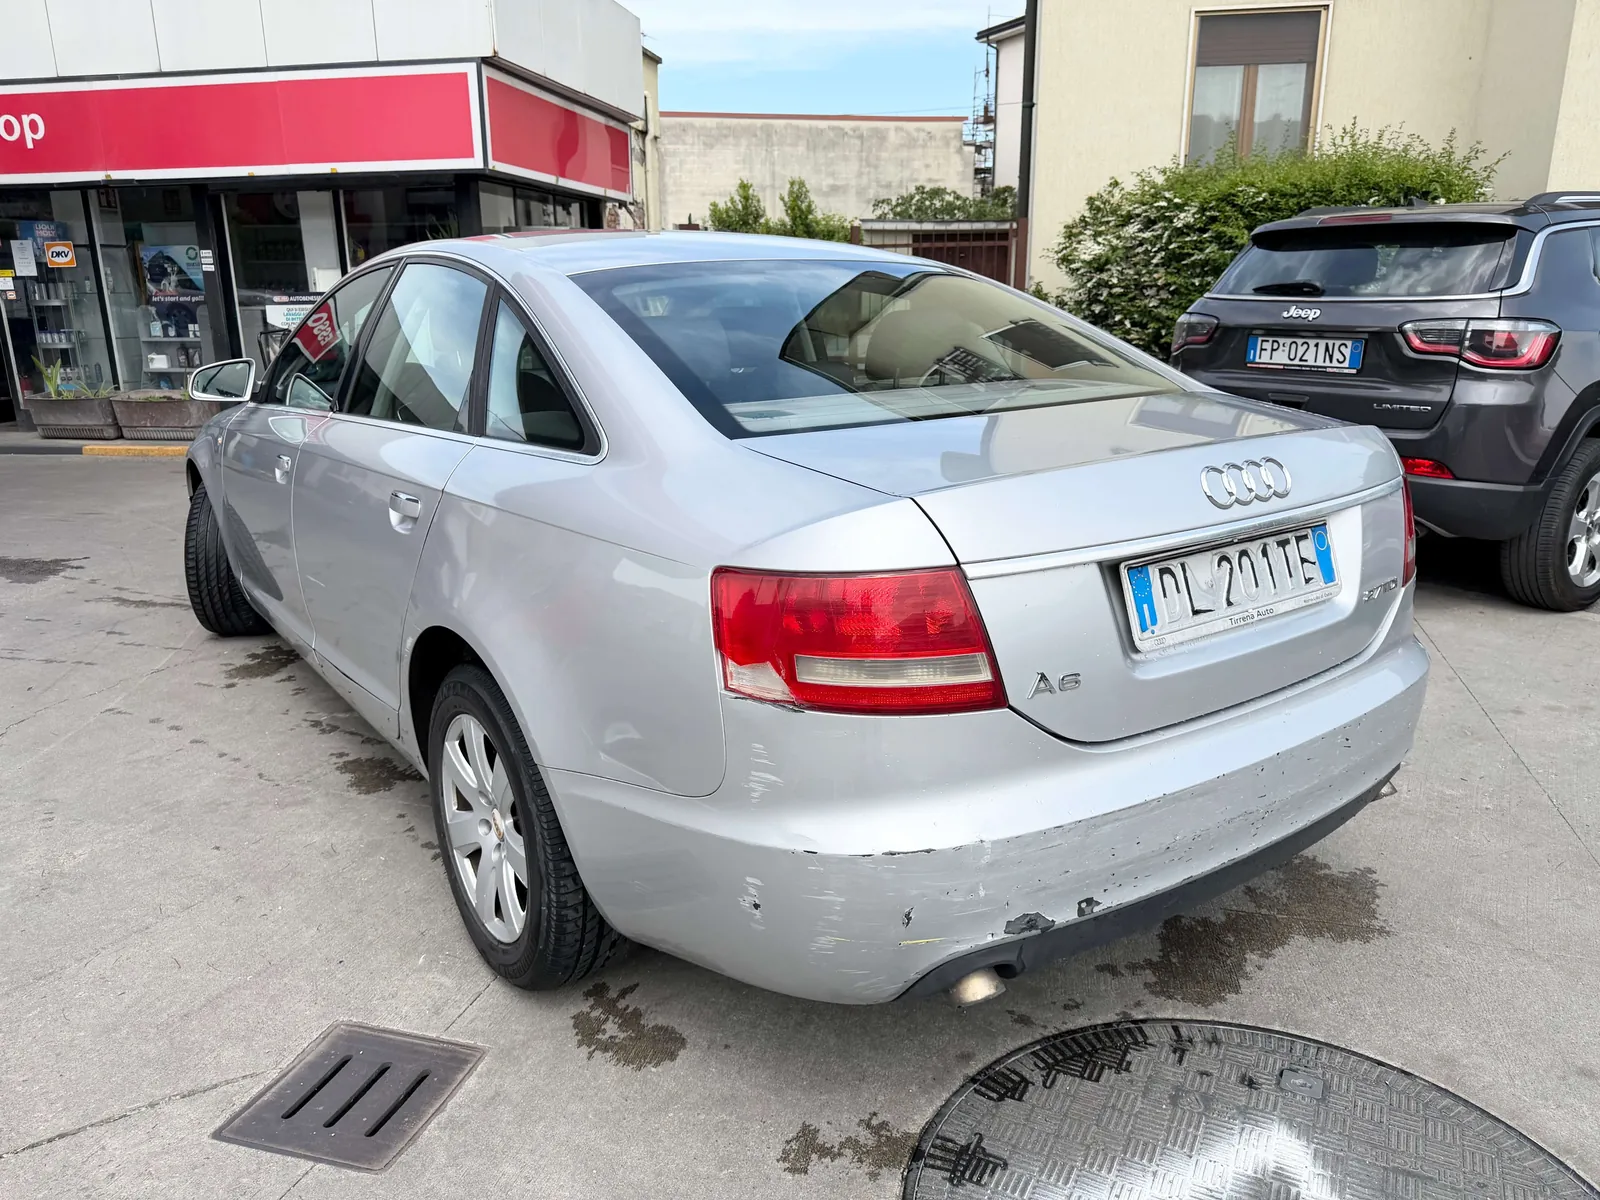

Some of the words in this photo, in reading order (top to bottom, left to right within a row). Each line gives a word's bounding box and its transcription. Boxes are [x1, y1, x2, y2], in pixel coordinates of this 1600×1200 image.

[50, 250, 70, 259] DKV
[1282, 305, 1322, 321] Jeep
[1373, 403, 1432, 413] LIMITED
[1228, 613, 1255, 626] Tirrena
[1256, 608, 1275, 618] Auto
[1026, 671, 1082, 700] A6
